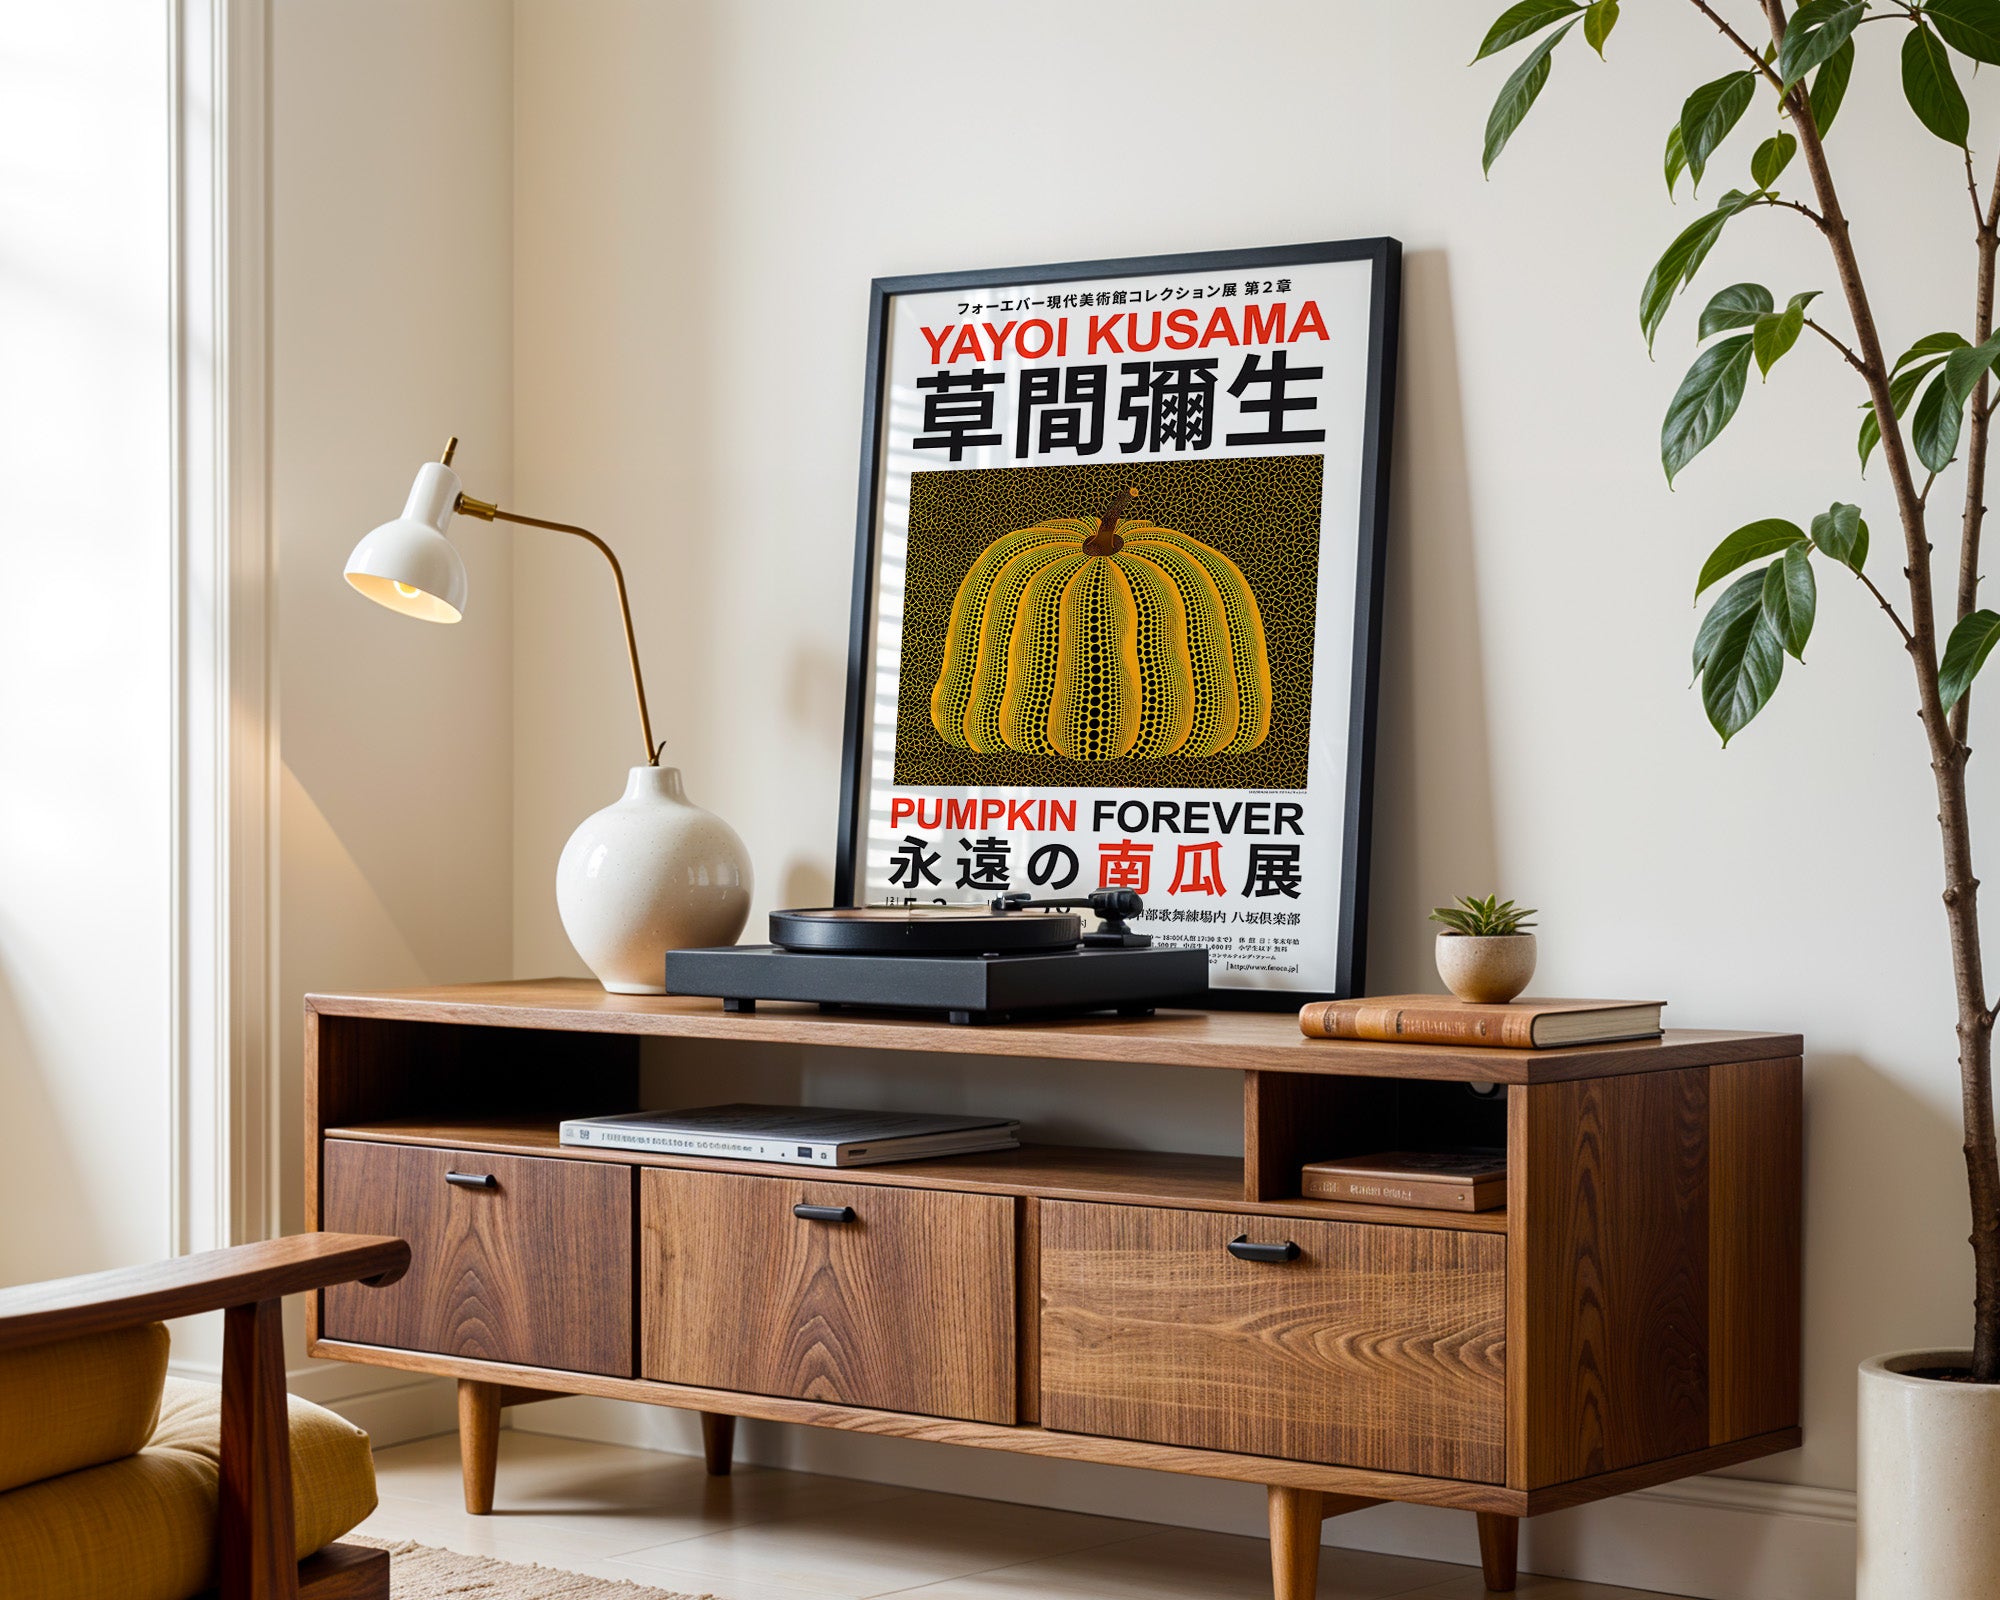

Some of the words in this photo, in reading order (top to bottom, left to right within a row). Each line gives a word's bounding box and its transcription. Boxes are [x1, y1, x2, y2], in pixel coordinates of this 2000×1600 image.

[957, 282, 1238, 315] フォーエバー現代美術館コレクション展
[920, 317, 1069, 364] YAYOI
[1087, 300, 1330, 355] KUSAMA
[912, 350, 1327, 462] 草間彌生
[890, 798, 1077, 832] PUMPKIN
[1092, 799, 1304, 836] FOREVER
